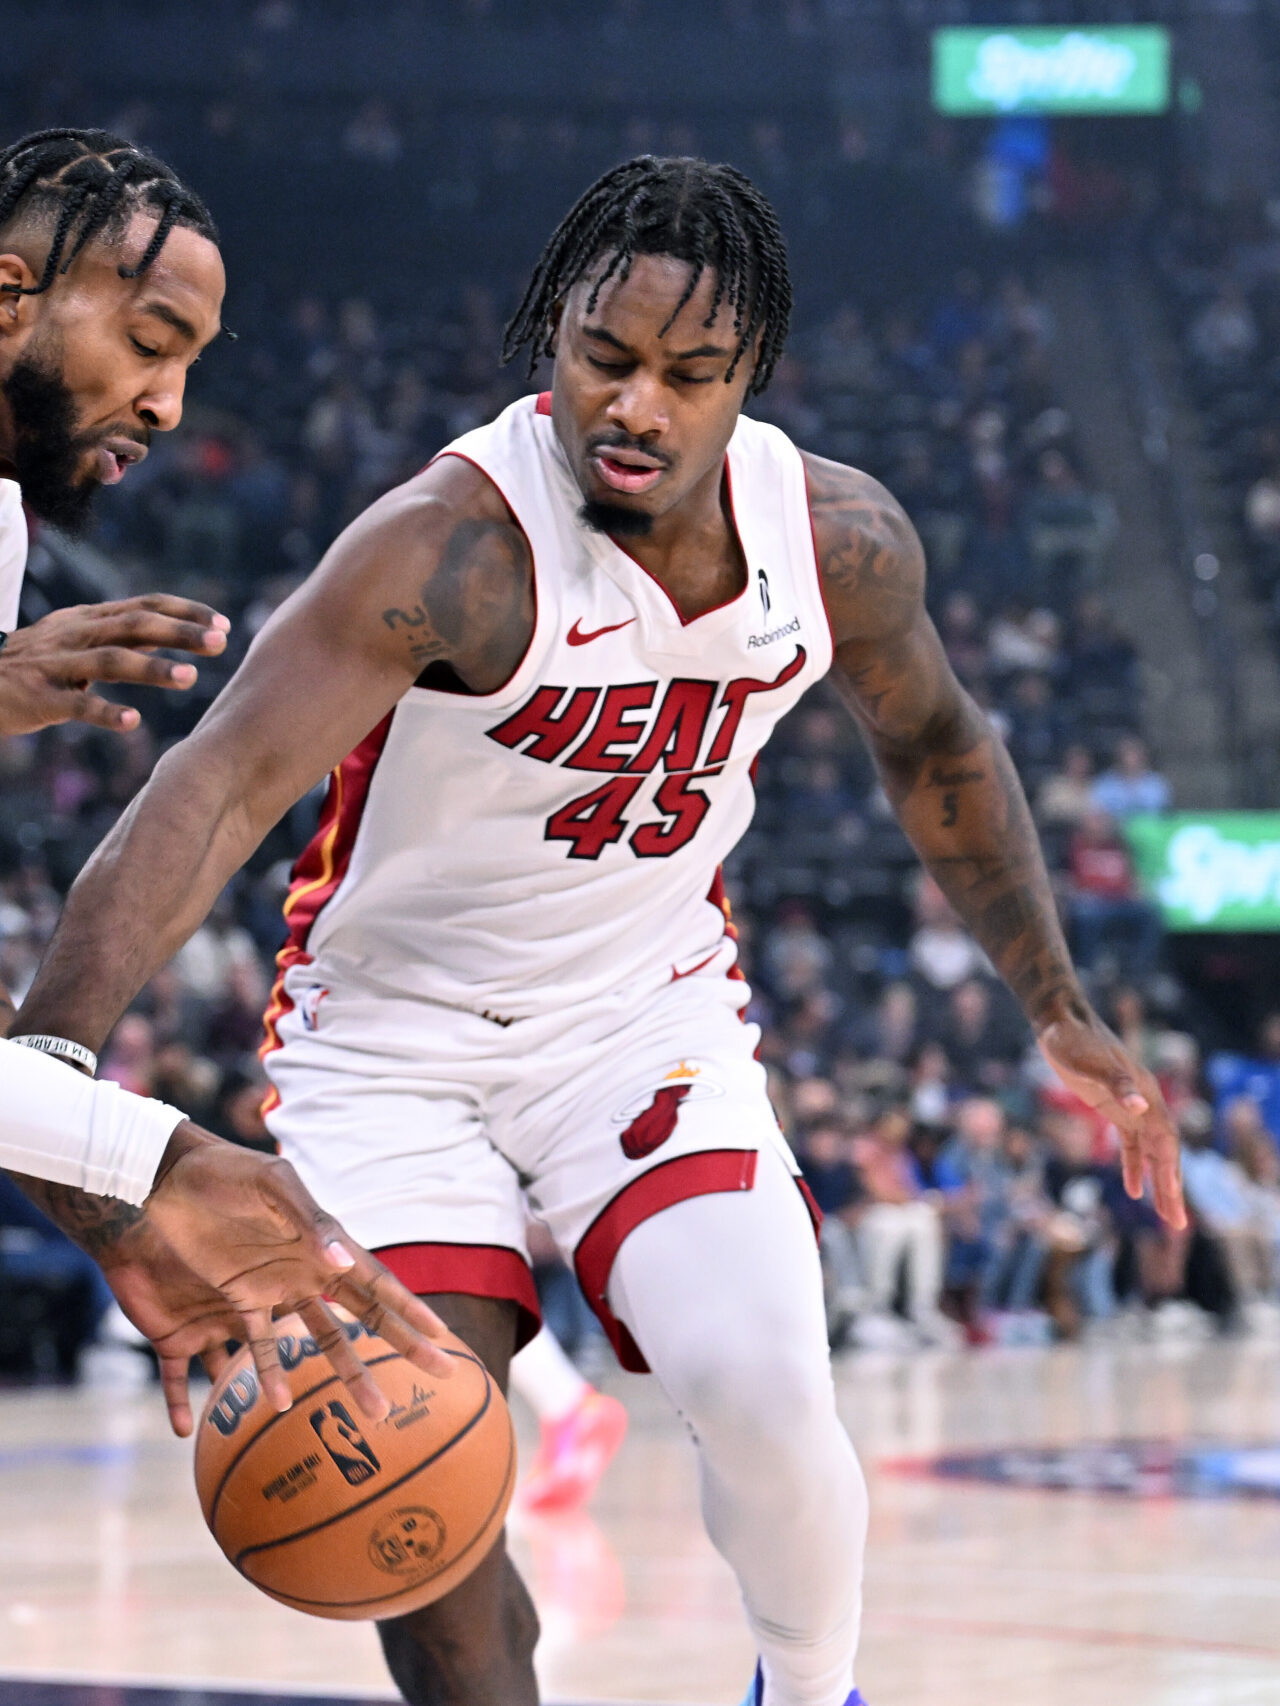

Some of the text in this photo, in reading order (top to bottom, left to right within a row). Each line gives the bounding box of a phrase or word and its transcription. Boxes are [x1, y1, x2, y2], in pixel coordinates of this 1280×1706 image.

[483, 643, 806, 774] HEAT
[543, 764, 724, 861] 45
[346, 1462, 371, 1484] NBA
